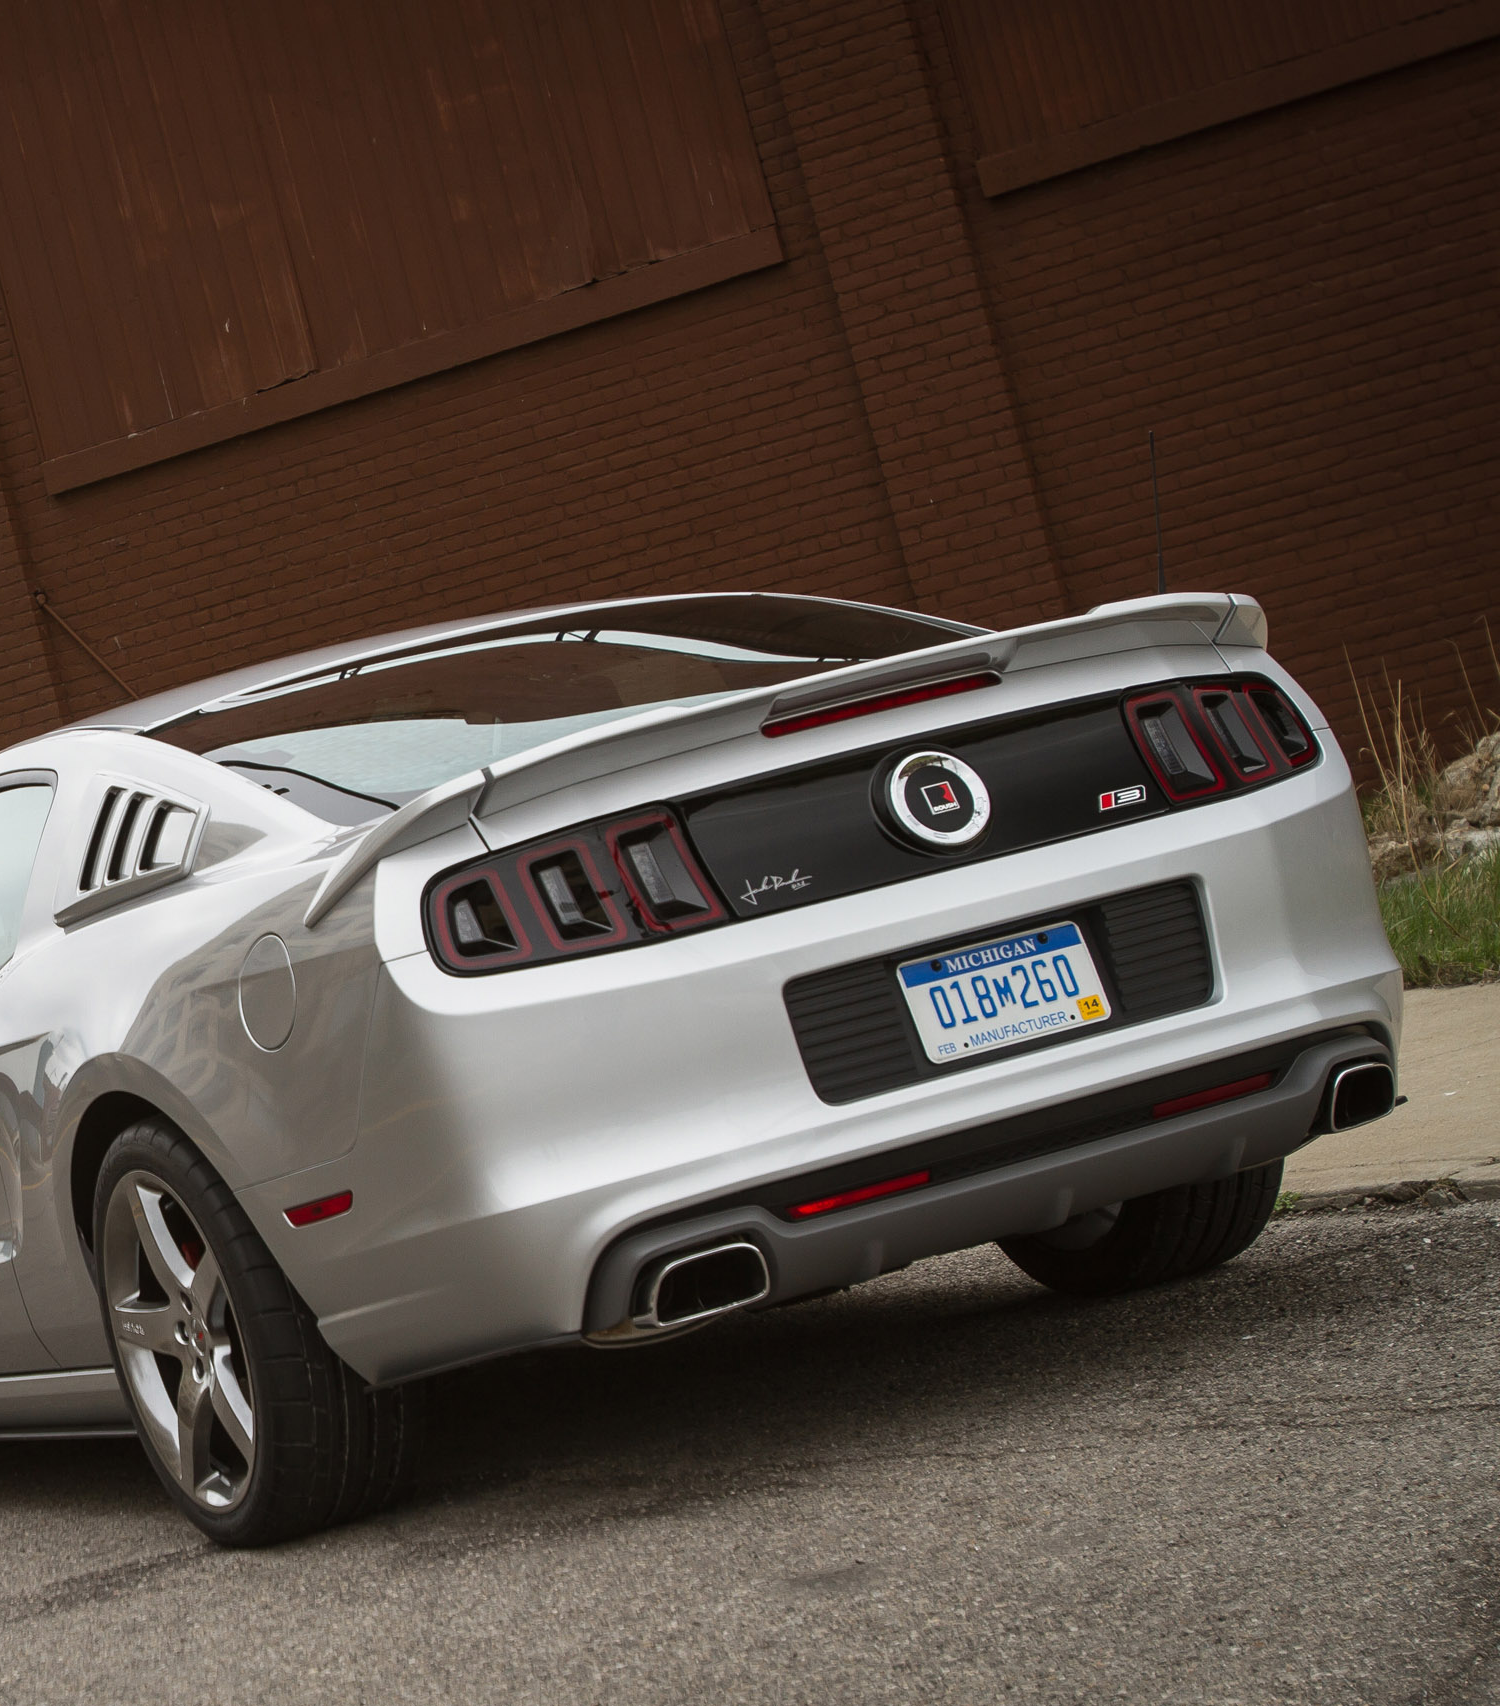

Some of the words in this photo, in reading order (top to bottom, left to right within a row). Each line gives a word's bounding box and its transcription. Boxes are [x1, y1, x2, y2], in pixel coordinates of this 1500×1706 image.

[944, 938, 1037, 973] MICHIGAN
[929, 954, 1080, 1029] 018M260
[1083, 998, 1099, 1010] 14
[938, 1042, 957, 1055] FEB
[969, 1010, 1068, 1047] MANUFACTURER
